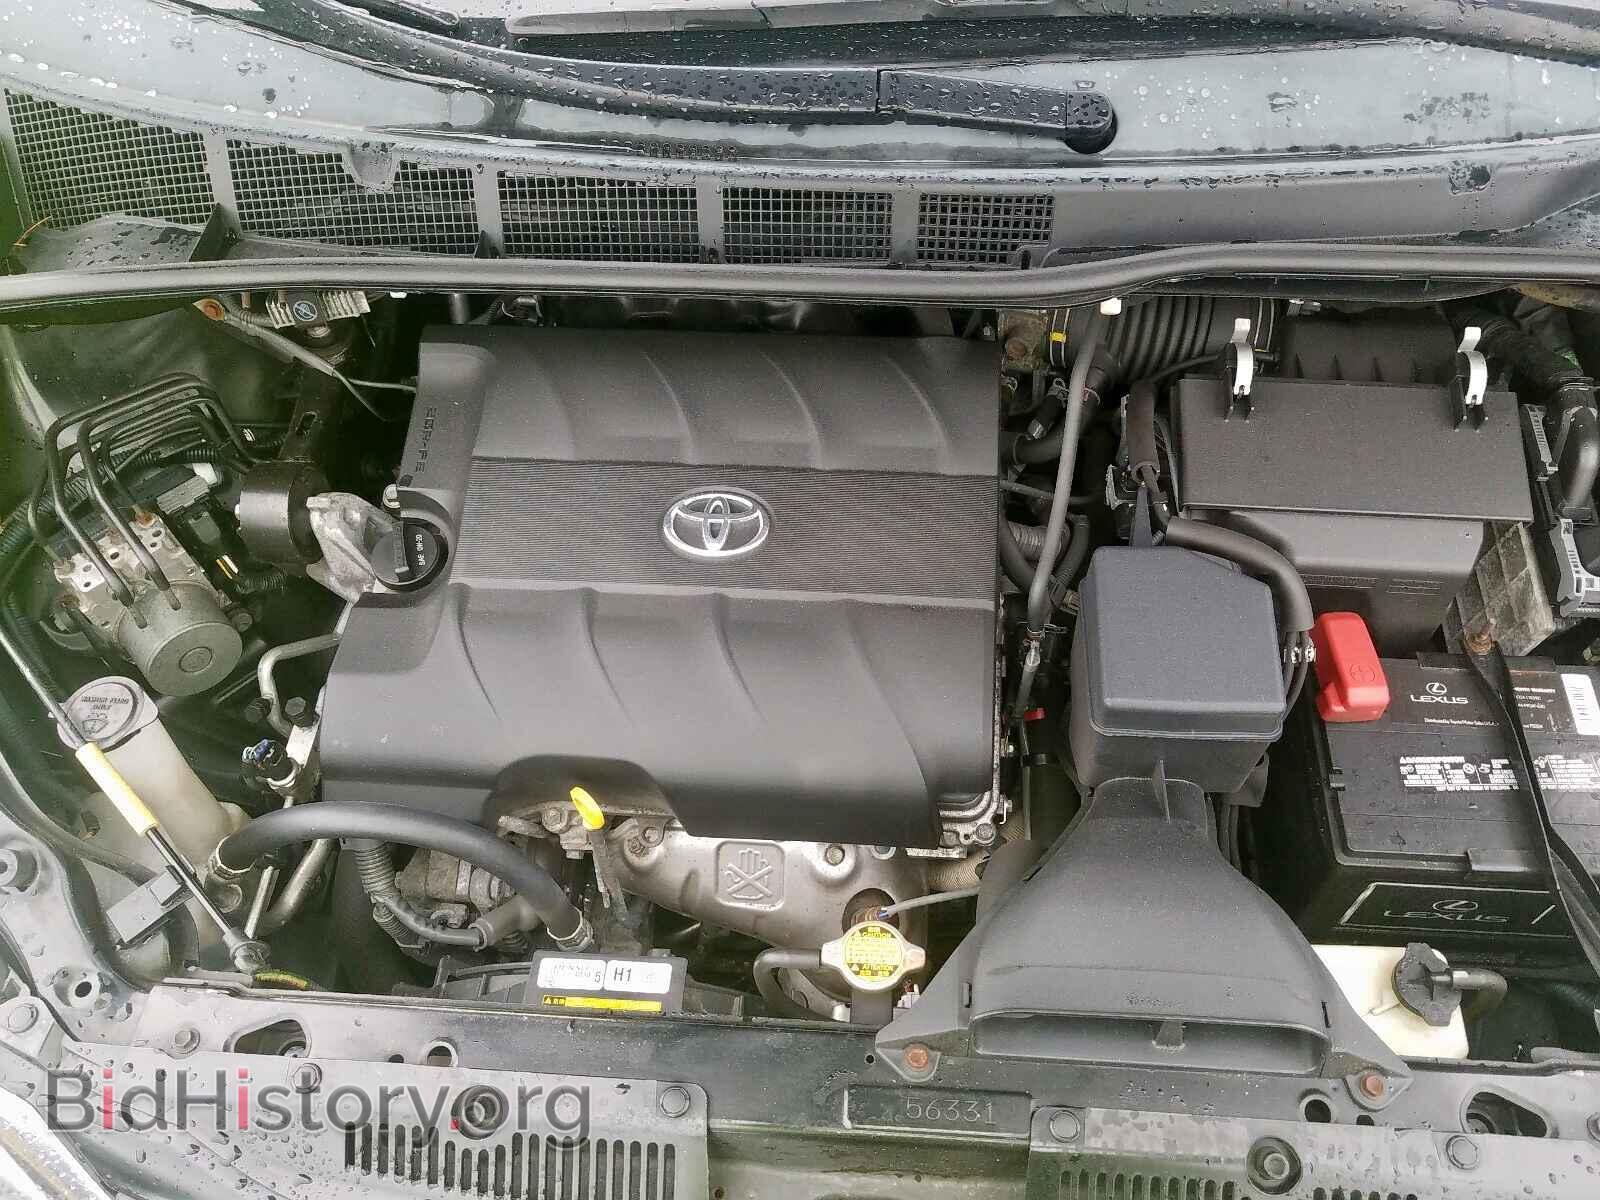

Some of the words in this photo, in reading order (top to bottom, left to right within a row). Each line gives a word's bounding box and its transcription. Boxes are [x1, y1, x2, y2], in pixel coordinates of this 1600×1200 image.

[1410, 694, 1469, 705] LEXUS
[1383, 910, 1510, 922] LEXUS
[613, 966, 632, 983] H1
[906, 1097, 997, 1126] 56331
